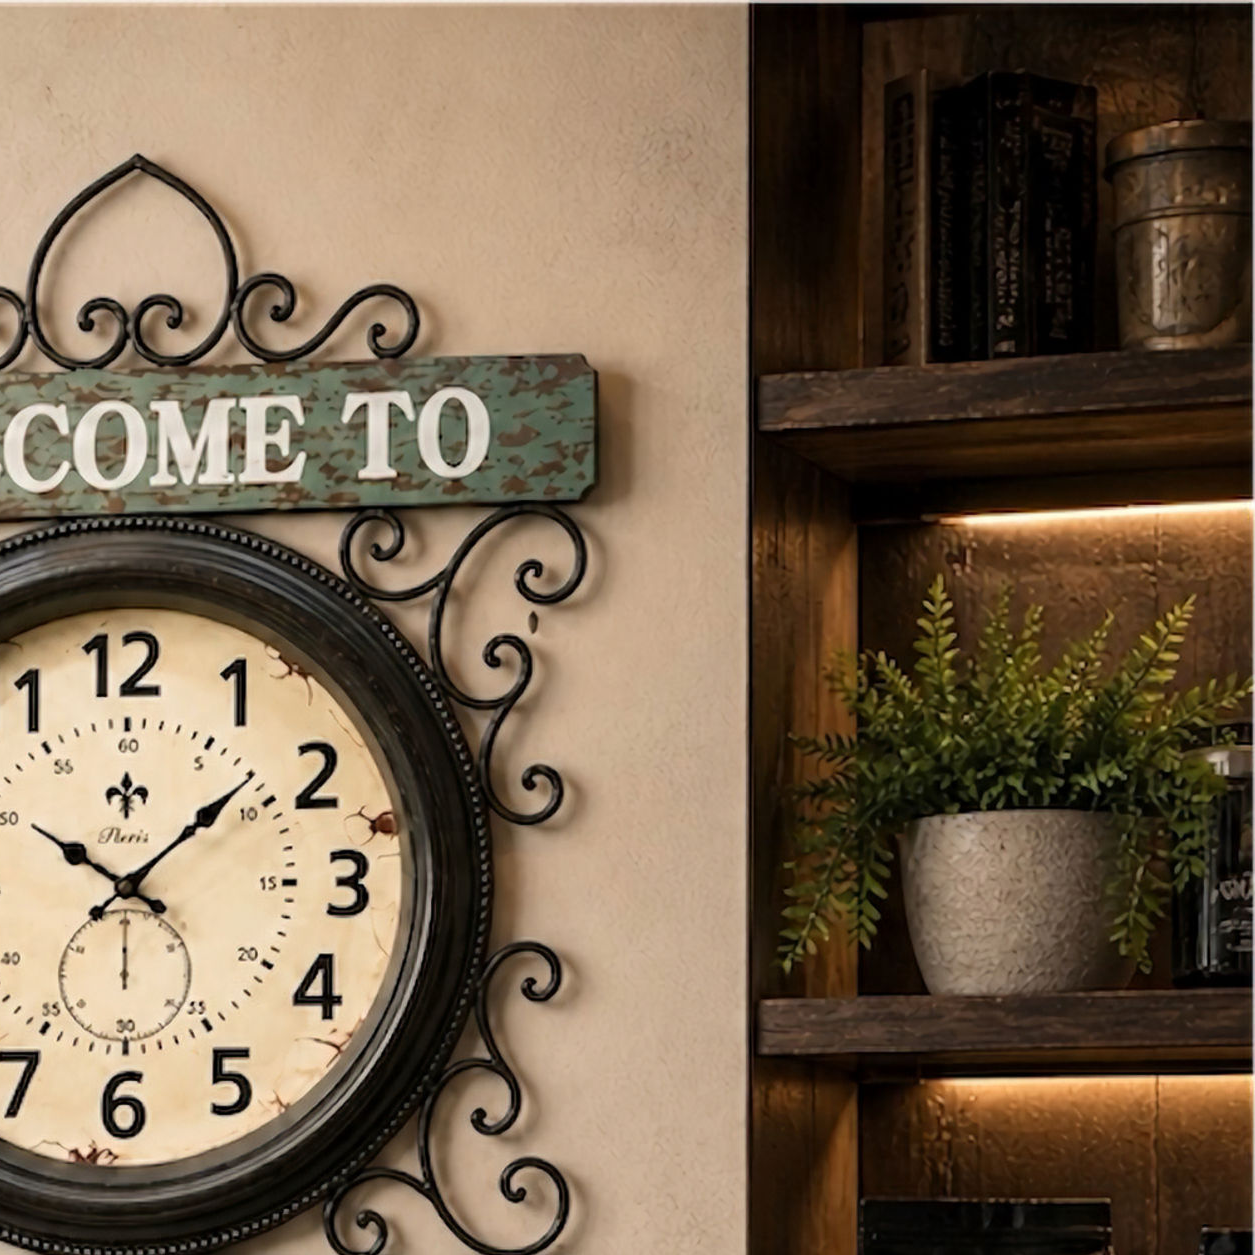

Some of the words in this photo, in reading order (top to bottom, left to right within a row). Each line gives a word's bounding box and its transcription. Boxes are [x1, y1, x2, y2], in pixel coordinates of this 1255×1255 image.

[341, 386, 491, 482] TO
[82, 631, 160, 697] 12
[220, 658, 247, 726] 1
[118, 739, 139, 753] 60
[295, 741, 338, 809] 2
[240, 807, 258, 822] 10
[259, 876, 277, 890] 15
[326, 849, 370, 916] 3
[0, 951, 21, 966] 40
[238, 947, 258, 962] 20
[293, 953, 342, 1020] 4
[116, 1019, 136, 1034] 30
[102, 1071, 146, 1138] 6
[211, 1048, 252, 1115] 5
